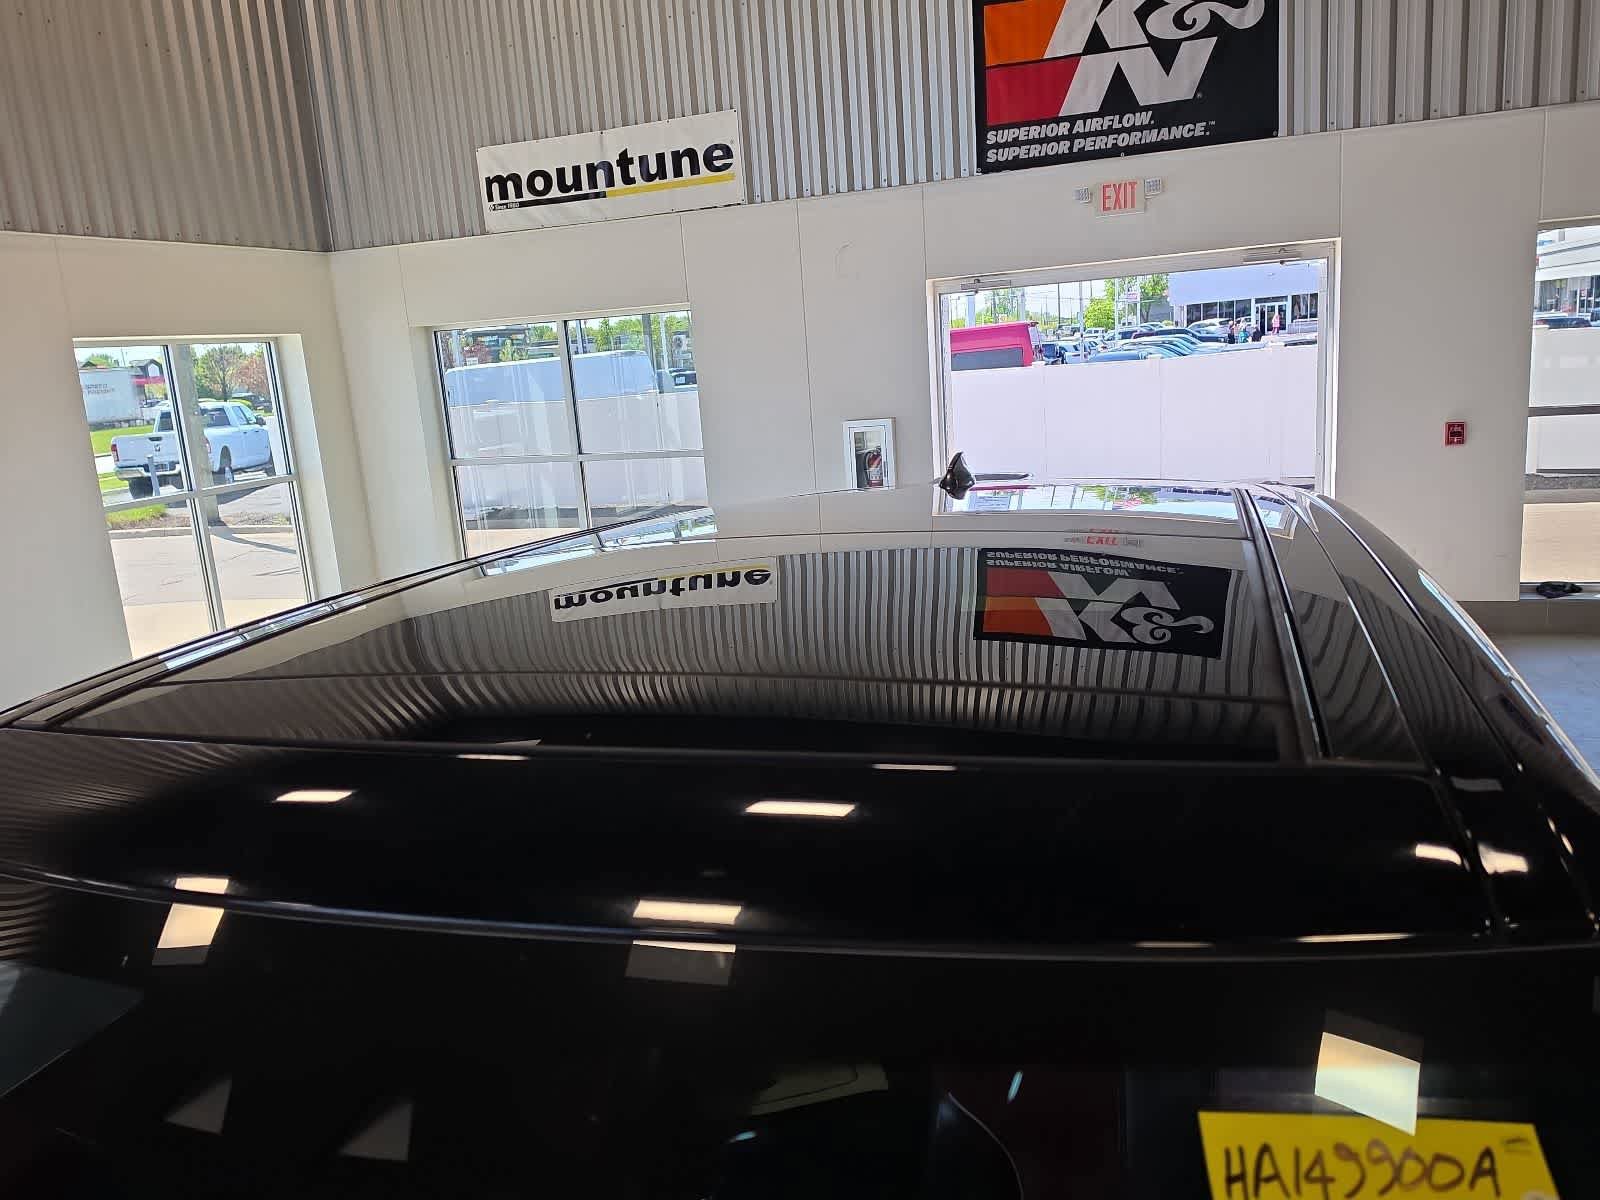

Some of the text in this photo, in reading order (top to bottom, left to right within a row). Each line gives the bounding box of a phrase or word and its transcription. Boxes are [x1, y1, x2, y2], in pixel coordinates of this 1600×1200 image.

[986, 111, 1155, 145] SUPERIOR AIRFLOW.
[986, 140, 1070, 163] SUPERIOR
[485, 143, 734, 202] mountune
[1101, 181, 1138, 213] EXIT
